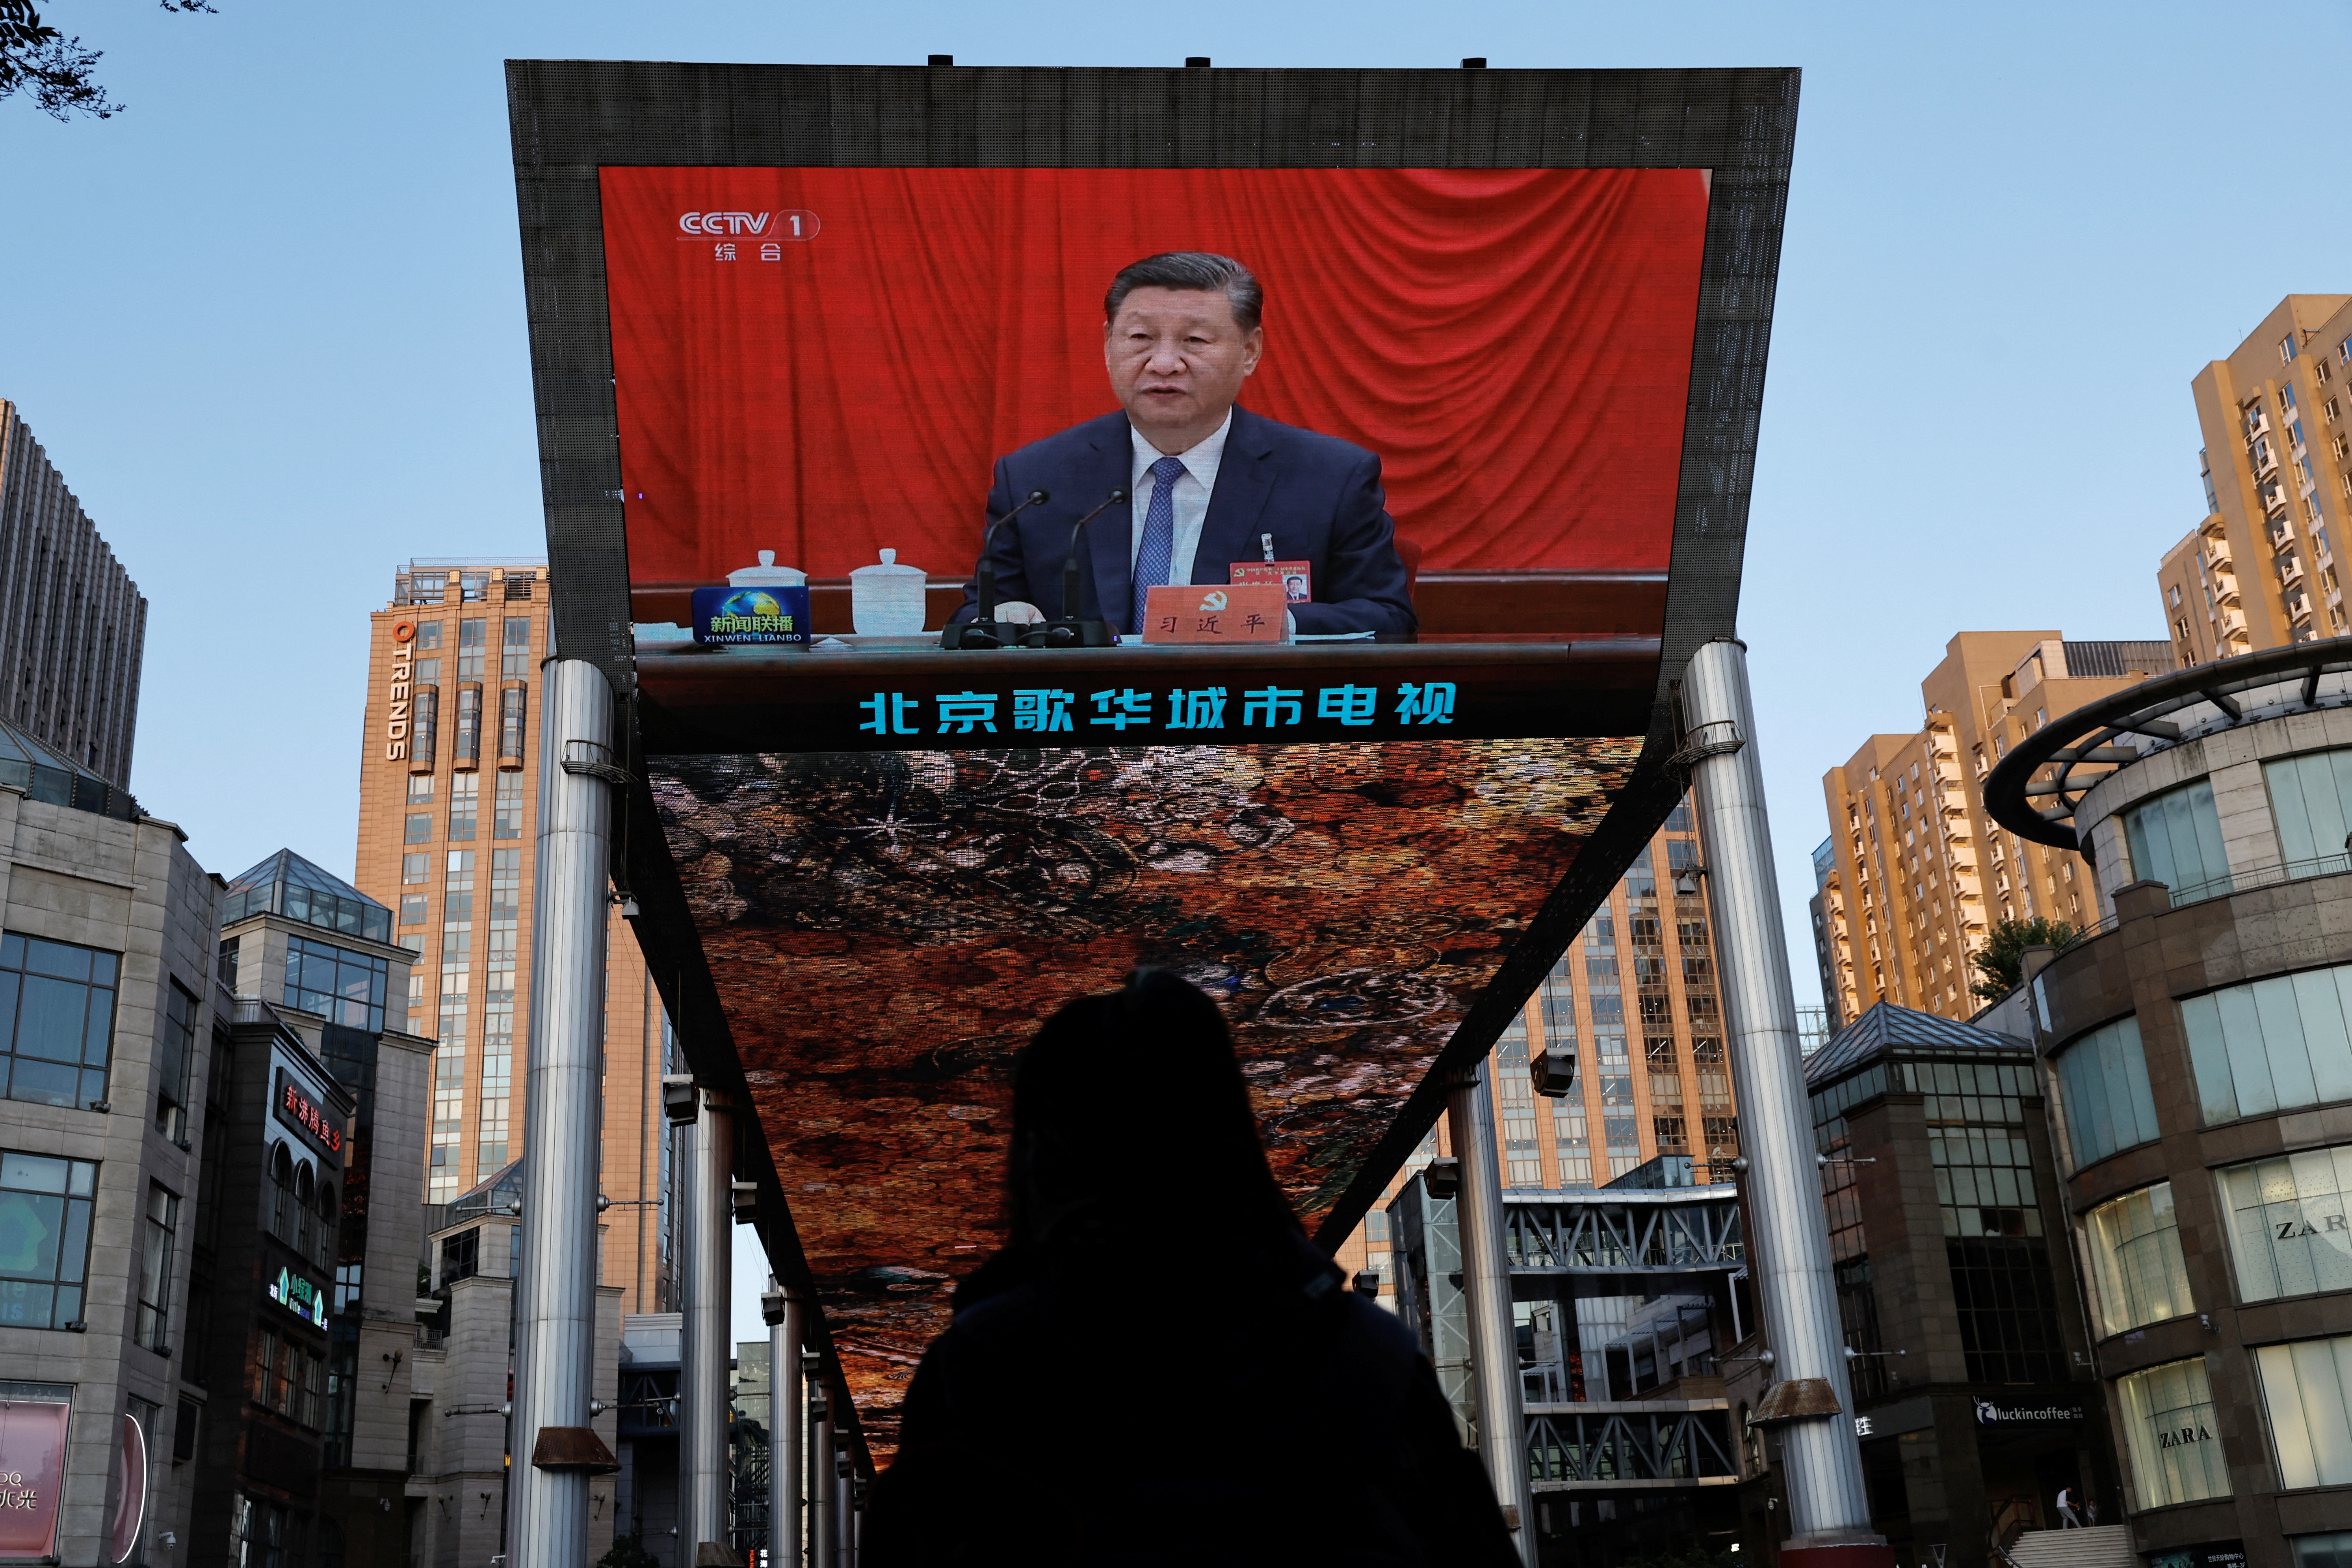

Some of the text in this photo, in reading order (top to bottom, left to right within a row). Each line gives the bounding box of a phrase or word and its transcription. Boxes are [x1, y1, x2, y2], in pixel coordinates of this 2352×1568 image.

[680, 212, 801, 236] CCTV 1
[715, 243, 781, 262] 综合
[711, 616, 793, 632] 新闻联播
[1160, 613, 1265, 635] 习近平
[704, 634, 802, 643] XINWEN LIANBO
[386, 643, 412, 761] TRENDS
[860, 682, 1457, 735] 北京歌华城市电视
[285, 1085, 341, 1151] 新沸腾鱼乡
[2160, 1425, 2213, 1449] ZARA
